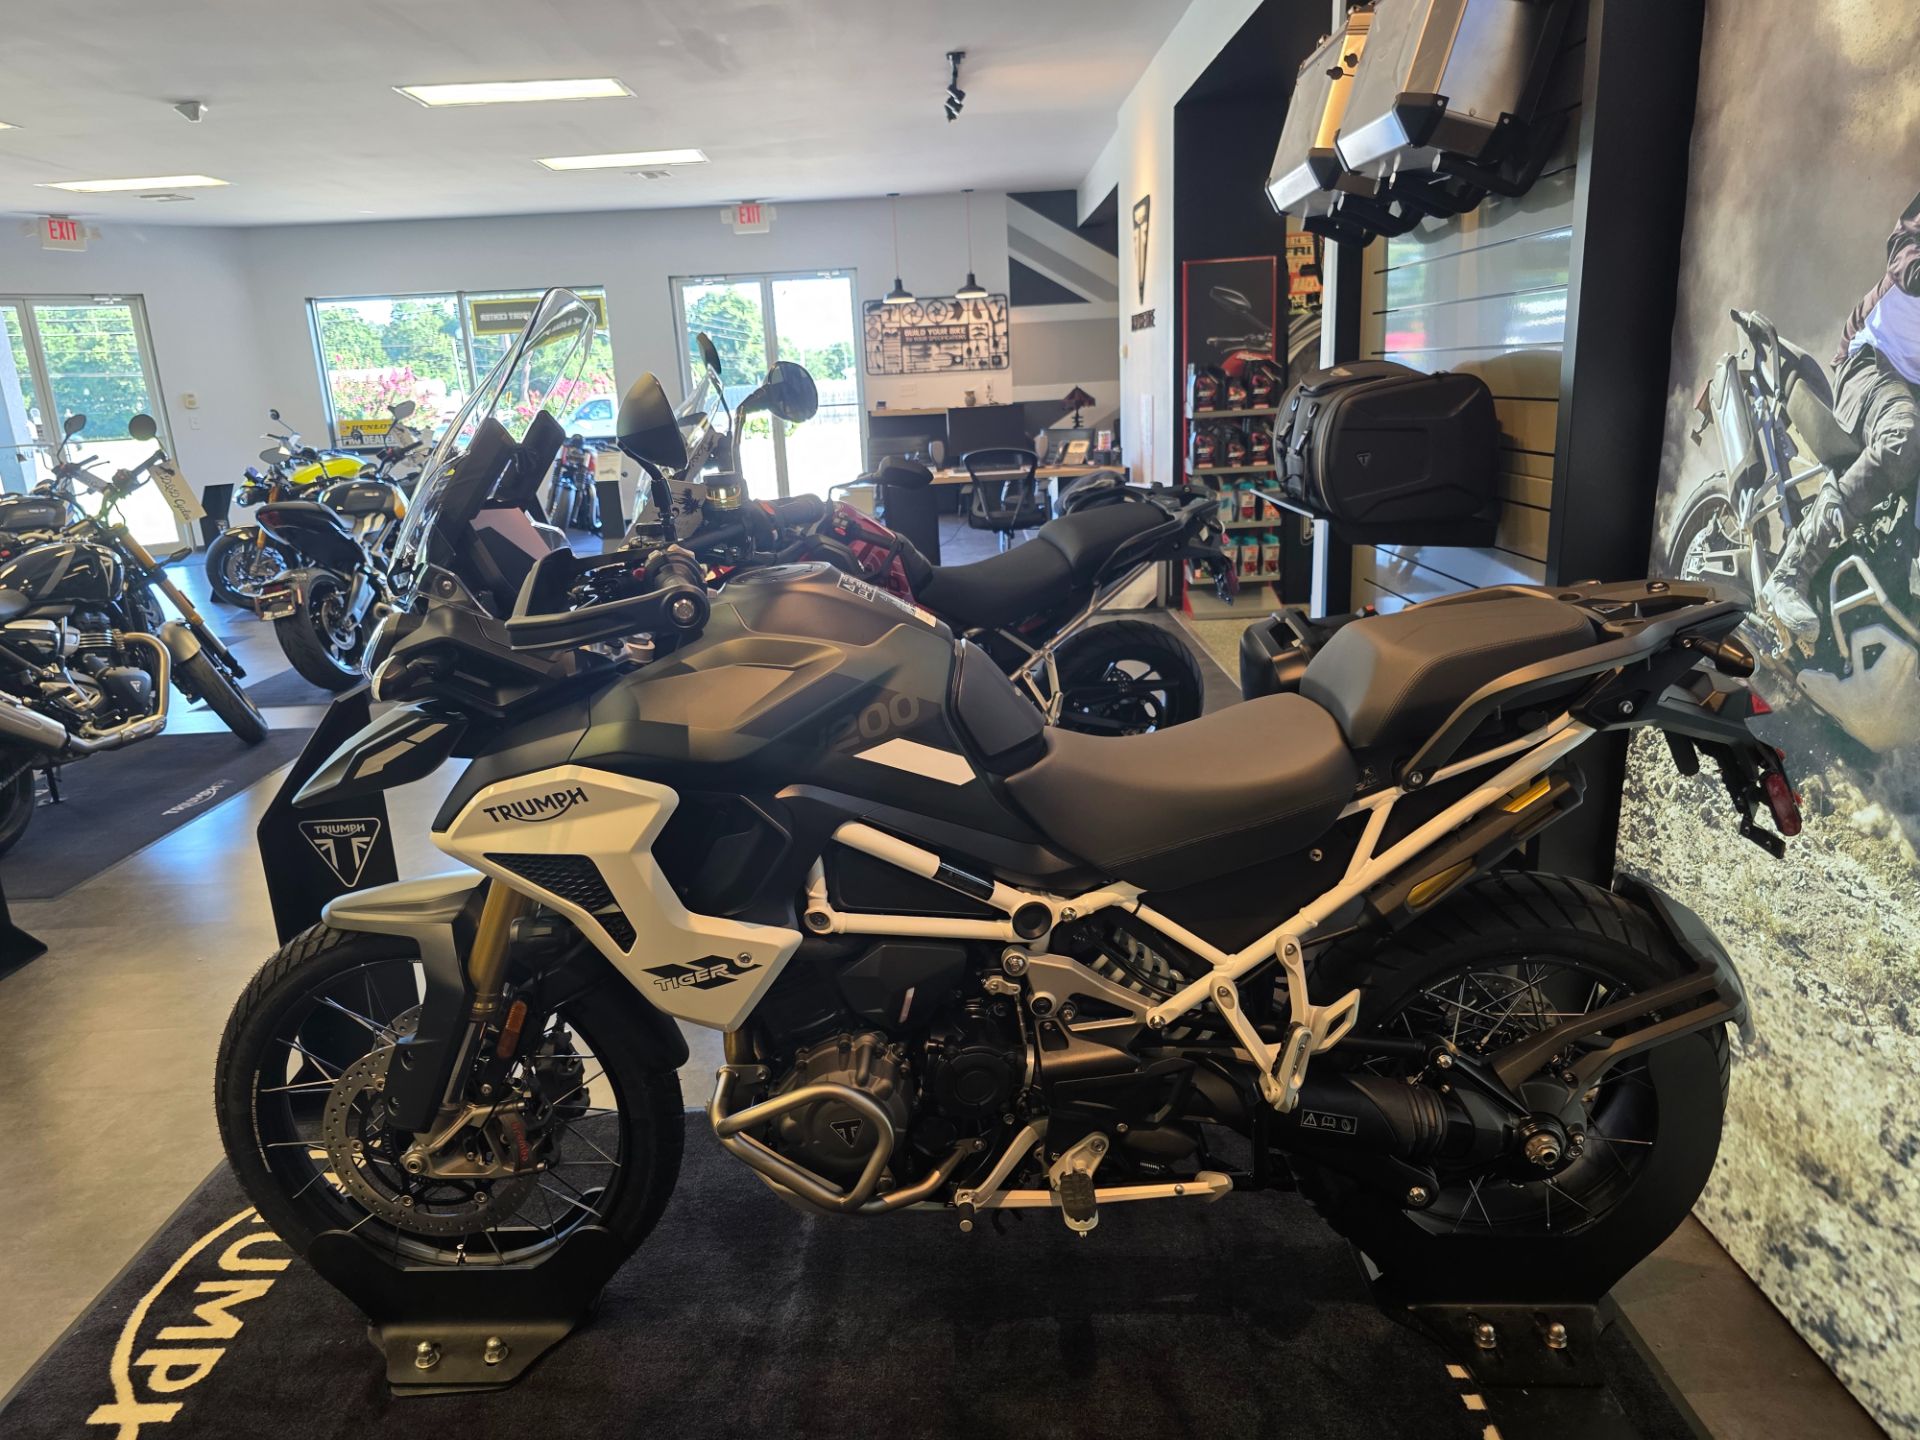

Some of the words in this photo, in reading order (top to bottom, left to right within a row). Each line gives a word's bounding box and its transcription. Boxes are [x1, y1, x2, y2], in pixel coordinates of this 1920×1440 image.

[738, 204, 764, 224] EXIT
[48, 220, 77, 240] EXIT
[903, 328, 926, 338] BUILD
[927, 327, 948, 336] YOUR
[949, 326, 967, 335] BIKE
[483, 787, 589, 822] TRIUMPH
[314, 823, 366, 837] TRIUMPH
[654, 963, 731, 992] TIGER
